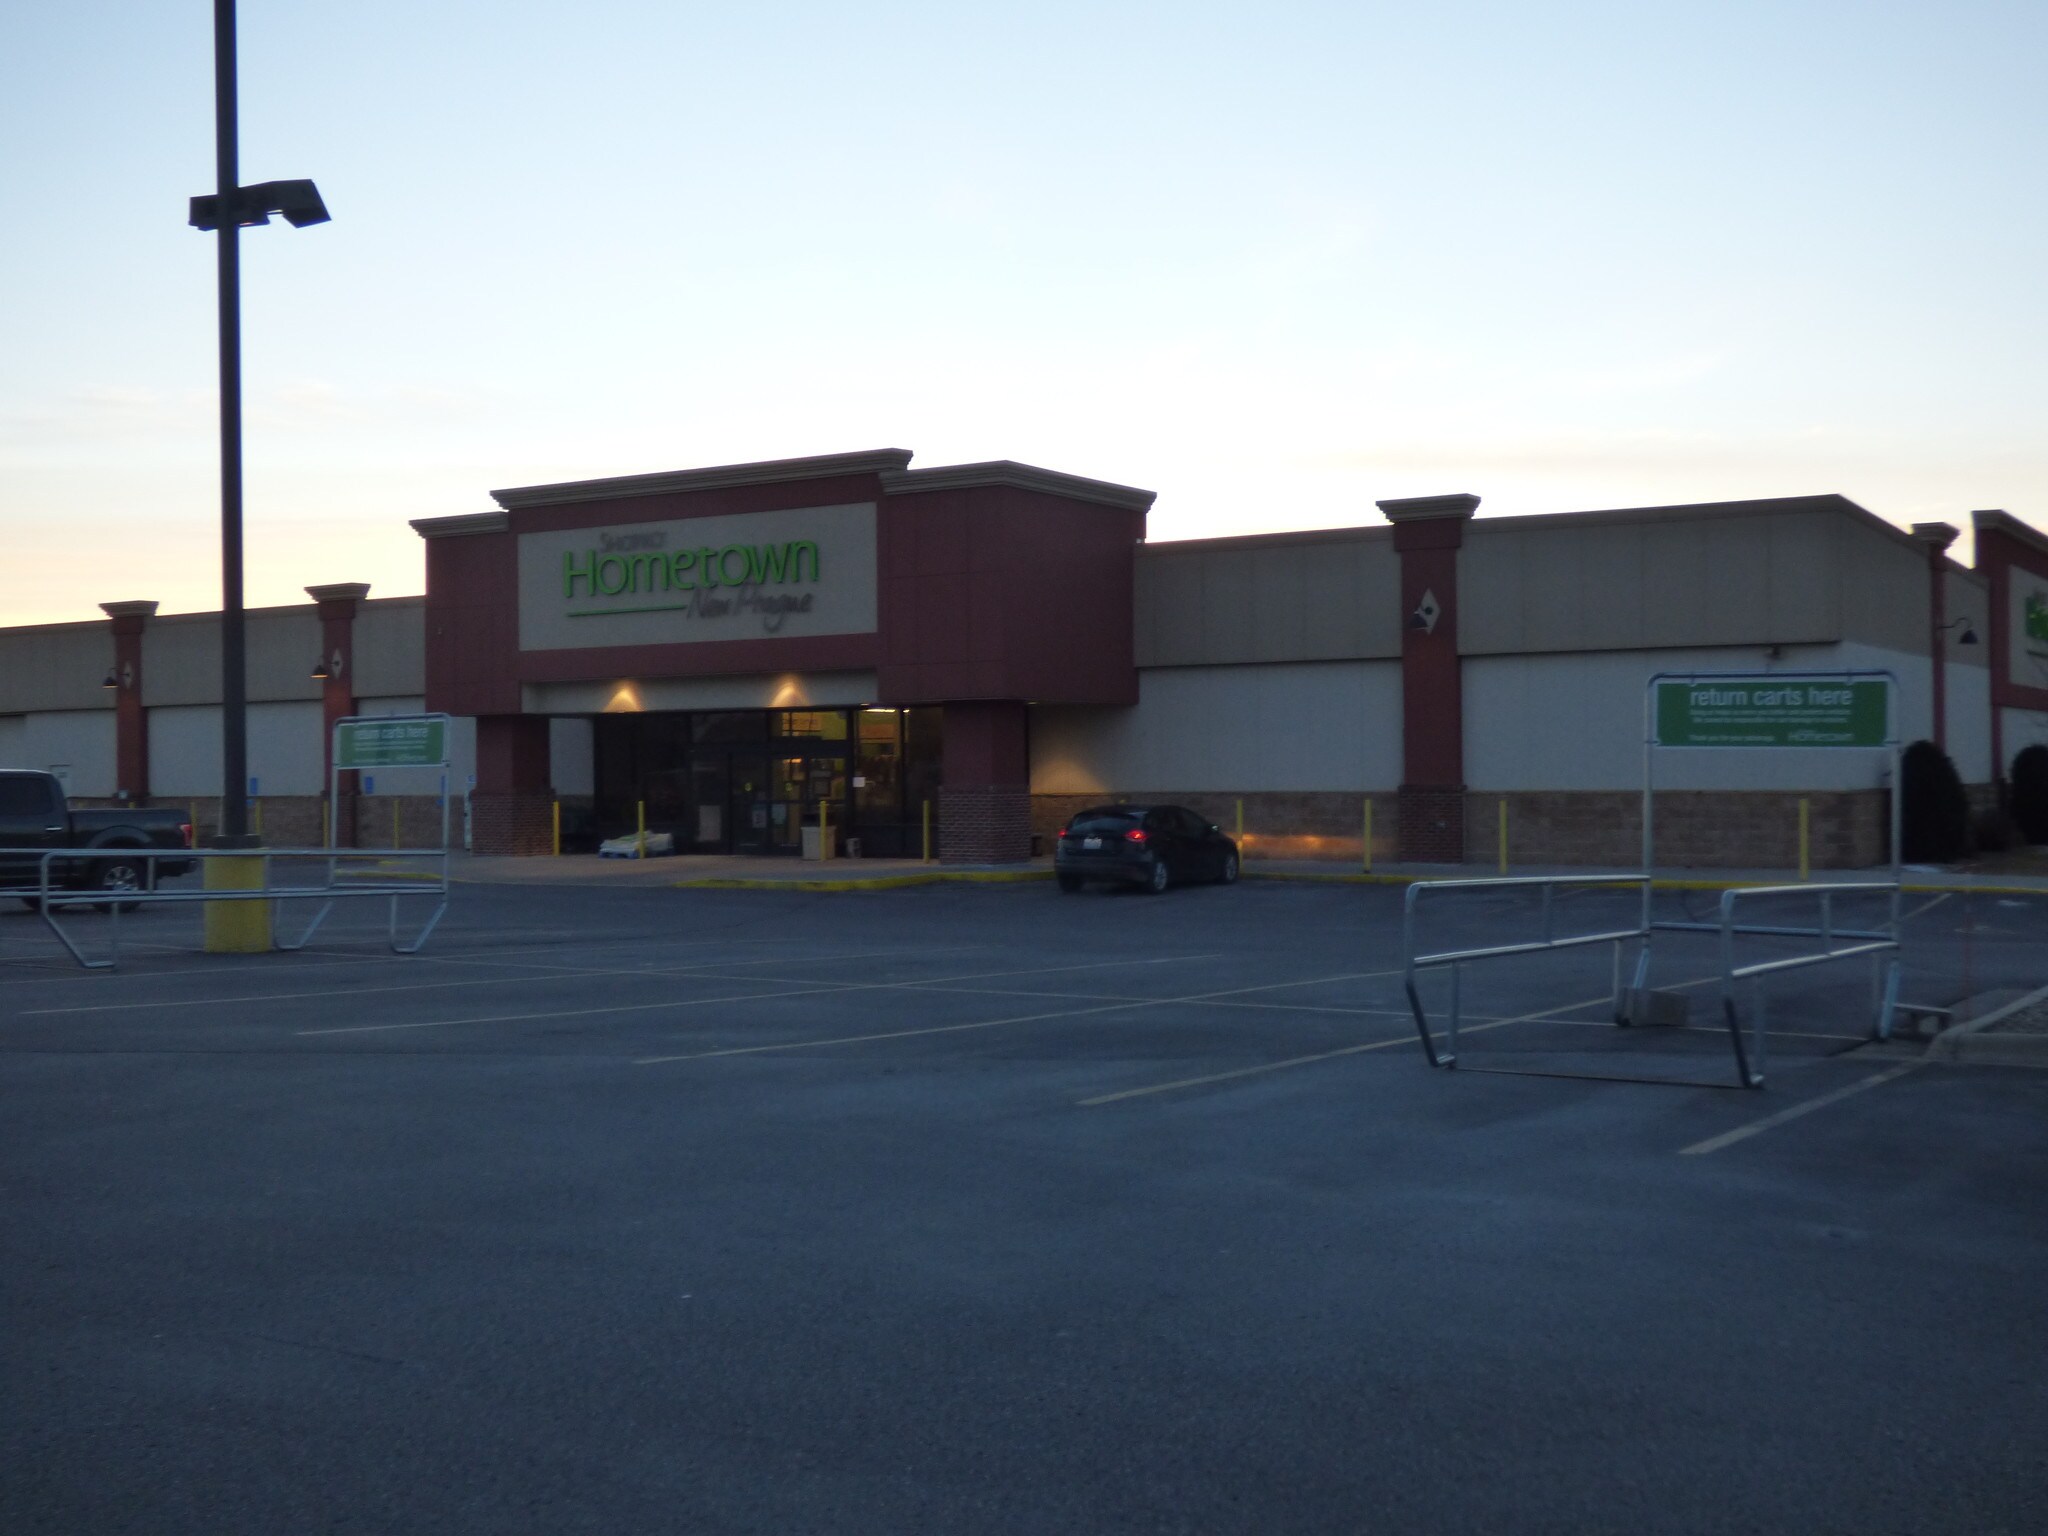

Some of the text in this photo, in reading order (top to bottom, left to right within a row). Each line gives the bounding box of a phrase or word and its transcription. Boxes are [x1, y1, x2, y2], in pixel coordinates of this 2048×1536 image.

[563, 539, 819, 598] Hometown
[1690, 687, 1854, 706] return carts here
